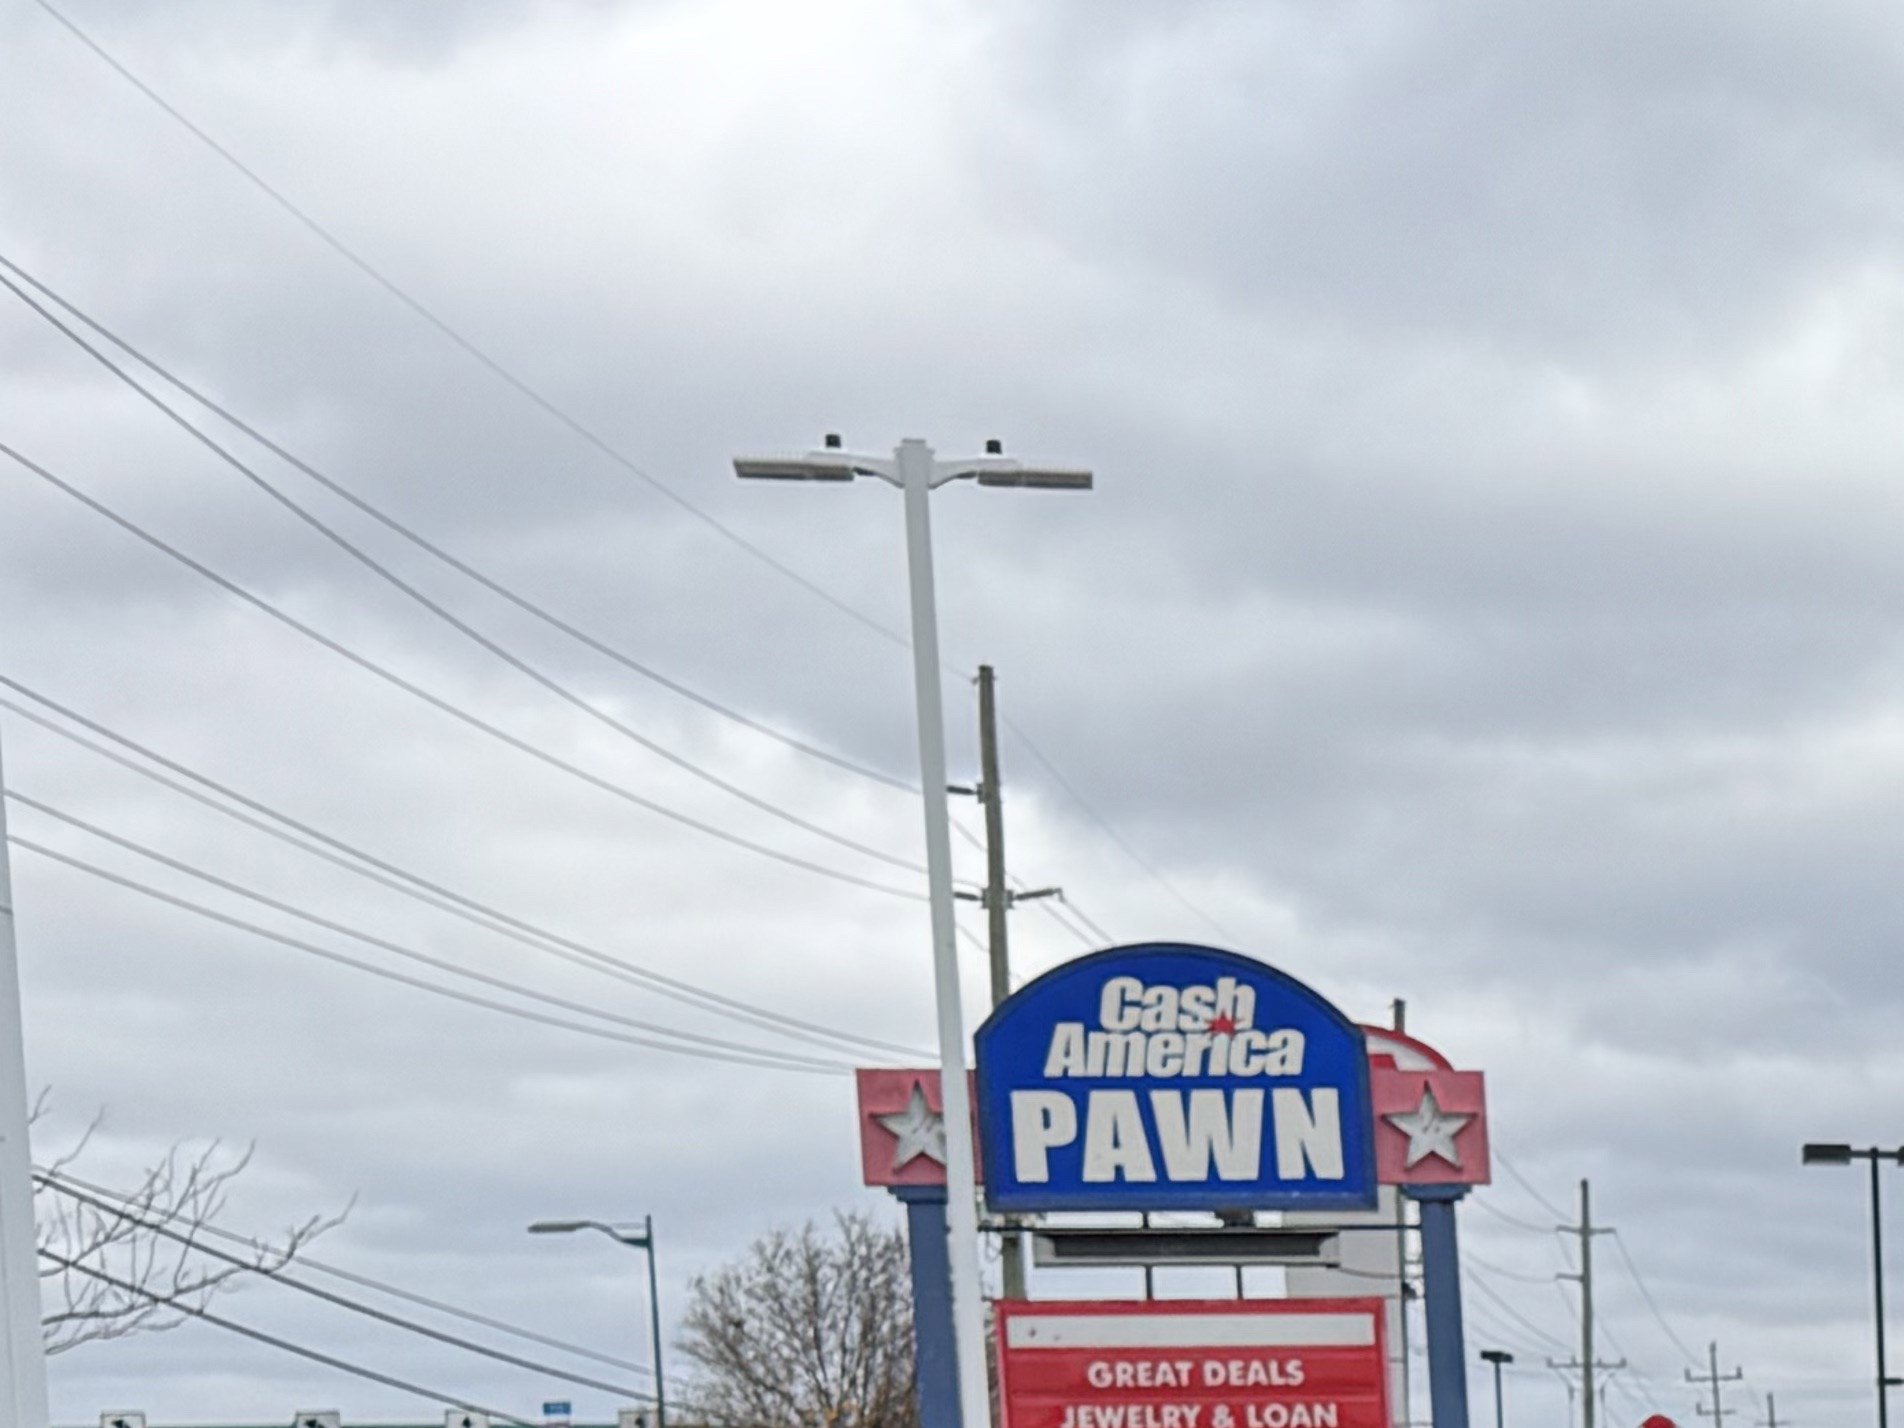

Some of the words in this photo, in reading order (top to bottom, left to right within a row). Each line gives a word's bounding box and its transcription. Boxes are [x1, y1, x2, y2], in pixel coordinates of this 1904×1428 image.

[1100, 976, 1255, 1031] Cash
[1044, 1021, 1305, 1078] America
[1010, 1088, 1344, 1183] PAWN
[1087, 1360, 1195, 1390] GREAT
[1203, 1359, 1305, 1388] DEALS
